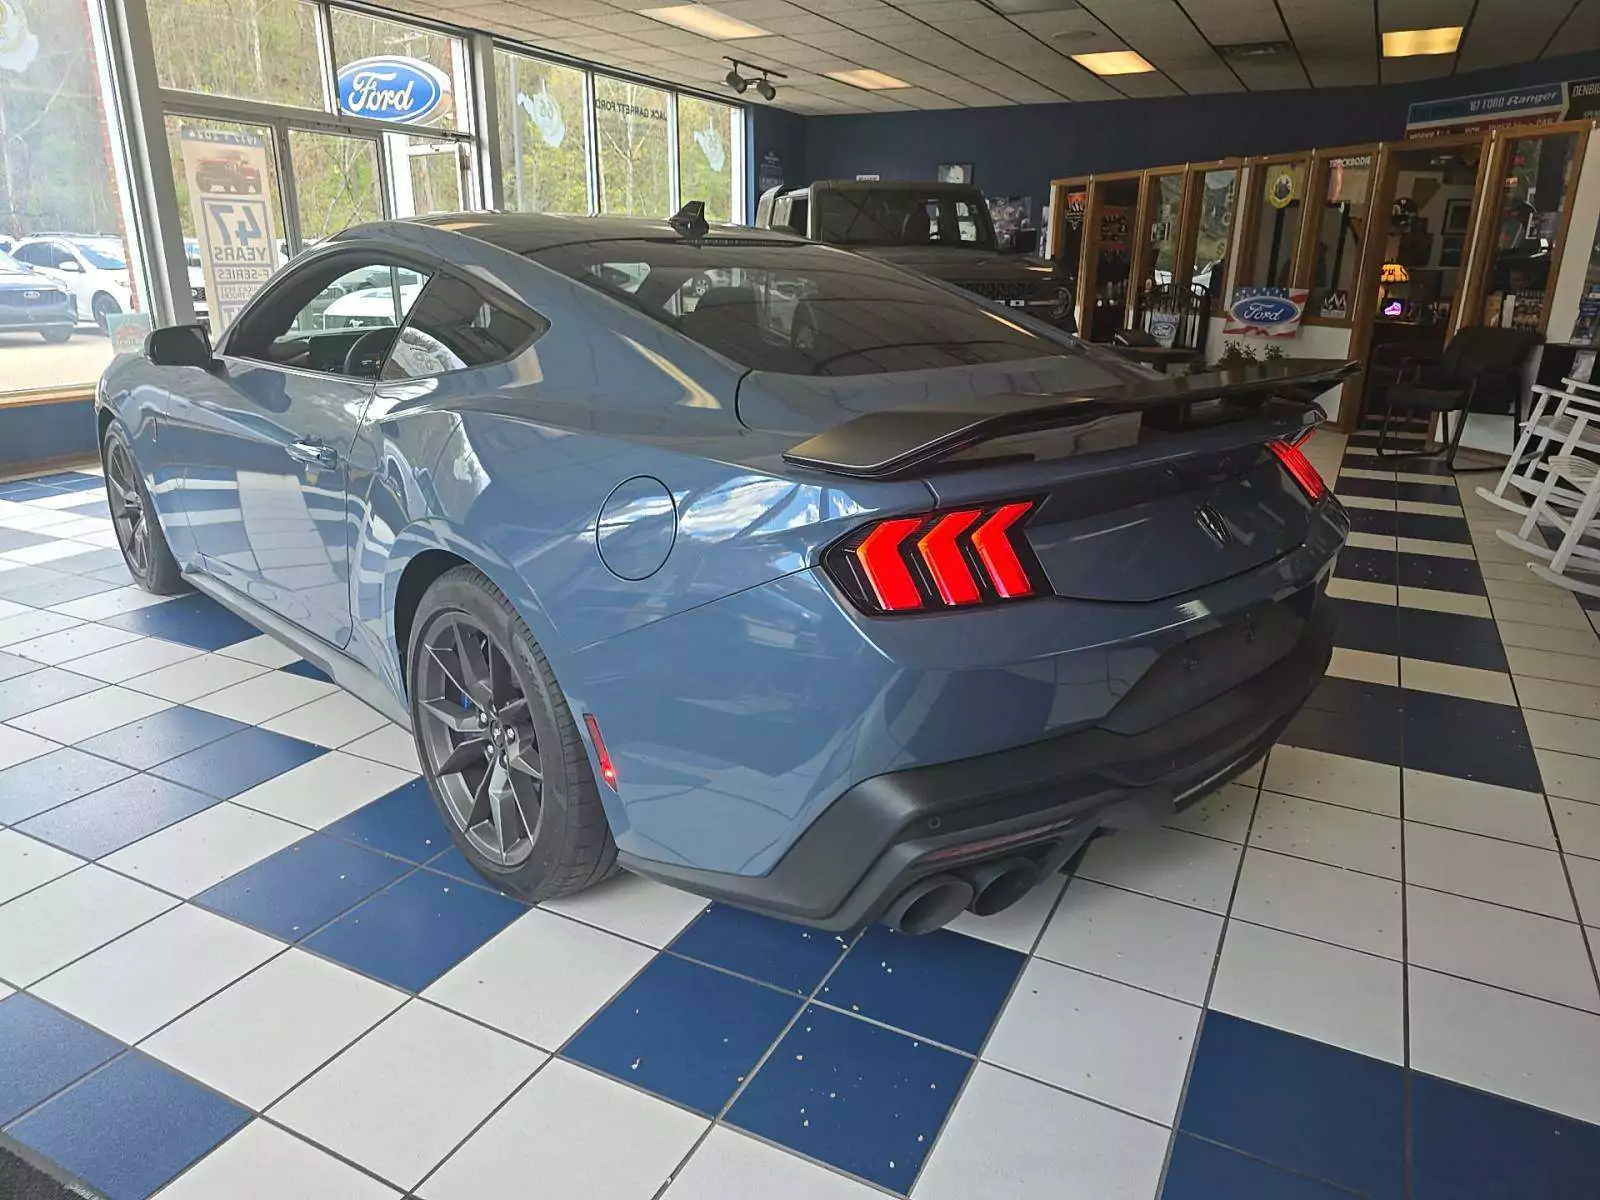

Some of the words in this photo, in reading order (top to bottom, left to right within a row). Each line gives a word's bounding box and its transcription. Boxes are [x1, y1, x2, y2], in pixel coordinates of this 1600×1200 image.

[348, 71, 415, 112] Ford
[1482, 98, 1505, 111] FORD
[1506, 91, 1558, 106] Ranger
[1243, 302, 1284, 321] Ford
